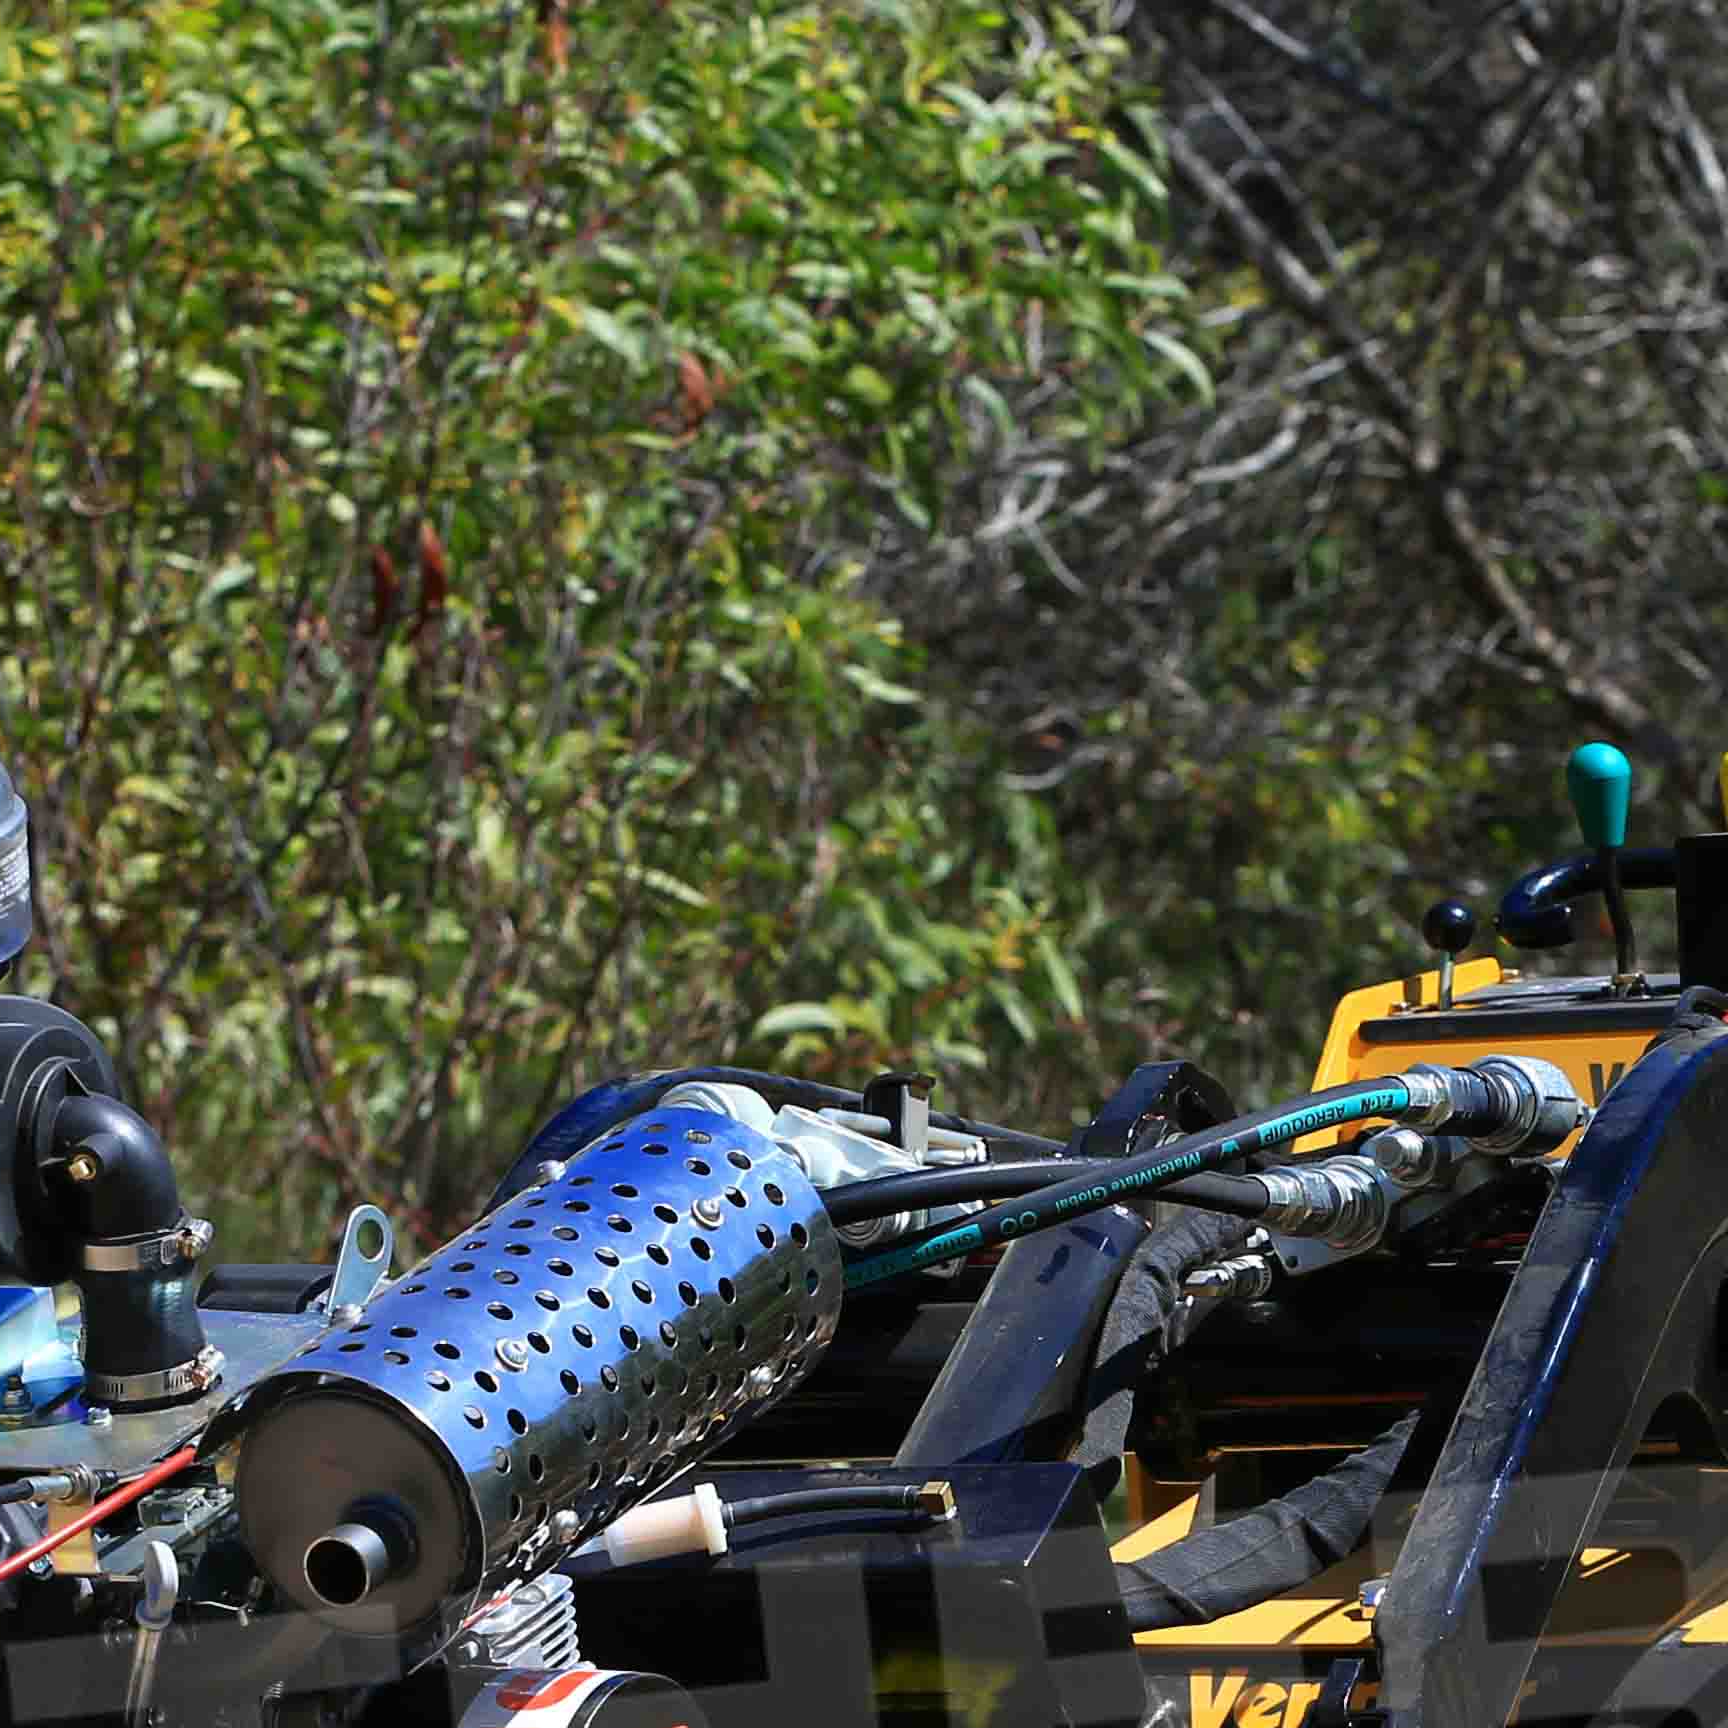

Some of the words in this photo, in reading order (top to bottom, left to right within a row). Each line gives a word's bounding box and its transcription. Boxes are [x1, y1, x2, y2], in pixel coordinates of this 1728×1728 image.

[1263, 1103, 1346, 1144] AEROQUIP
[1112, 1151, 1202, 1192] MatchMate
[1055, 1185, 1109, 1212] Global
